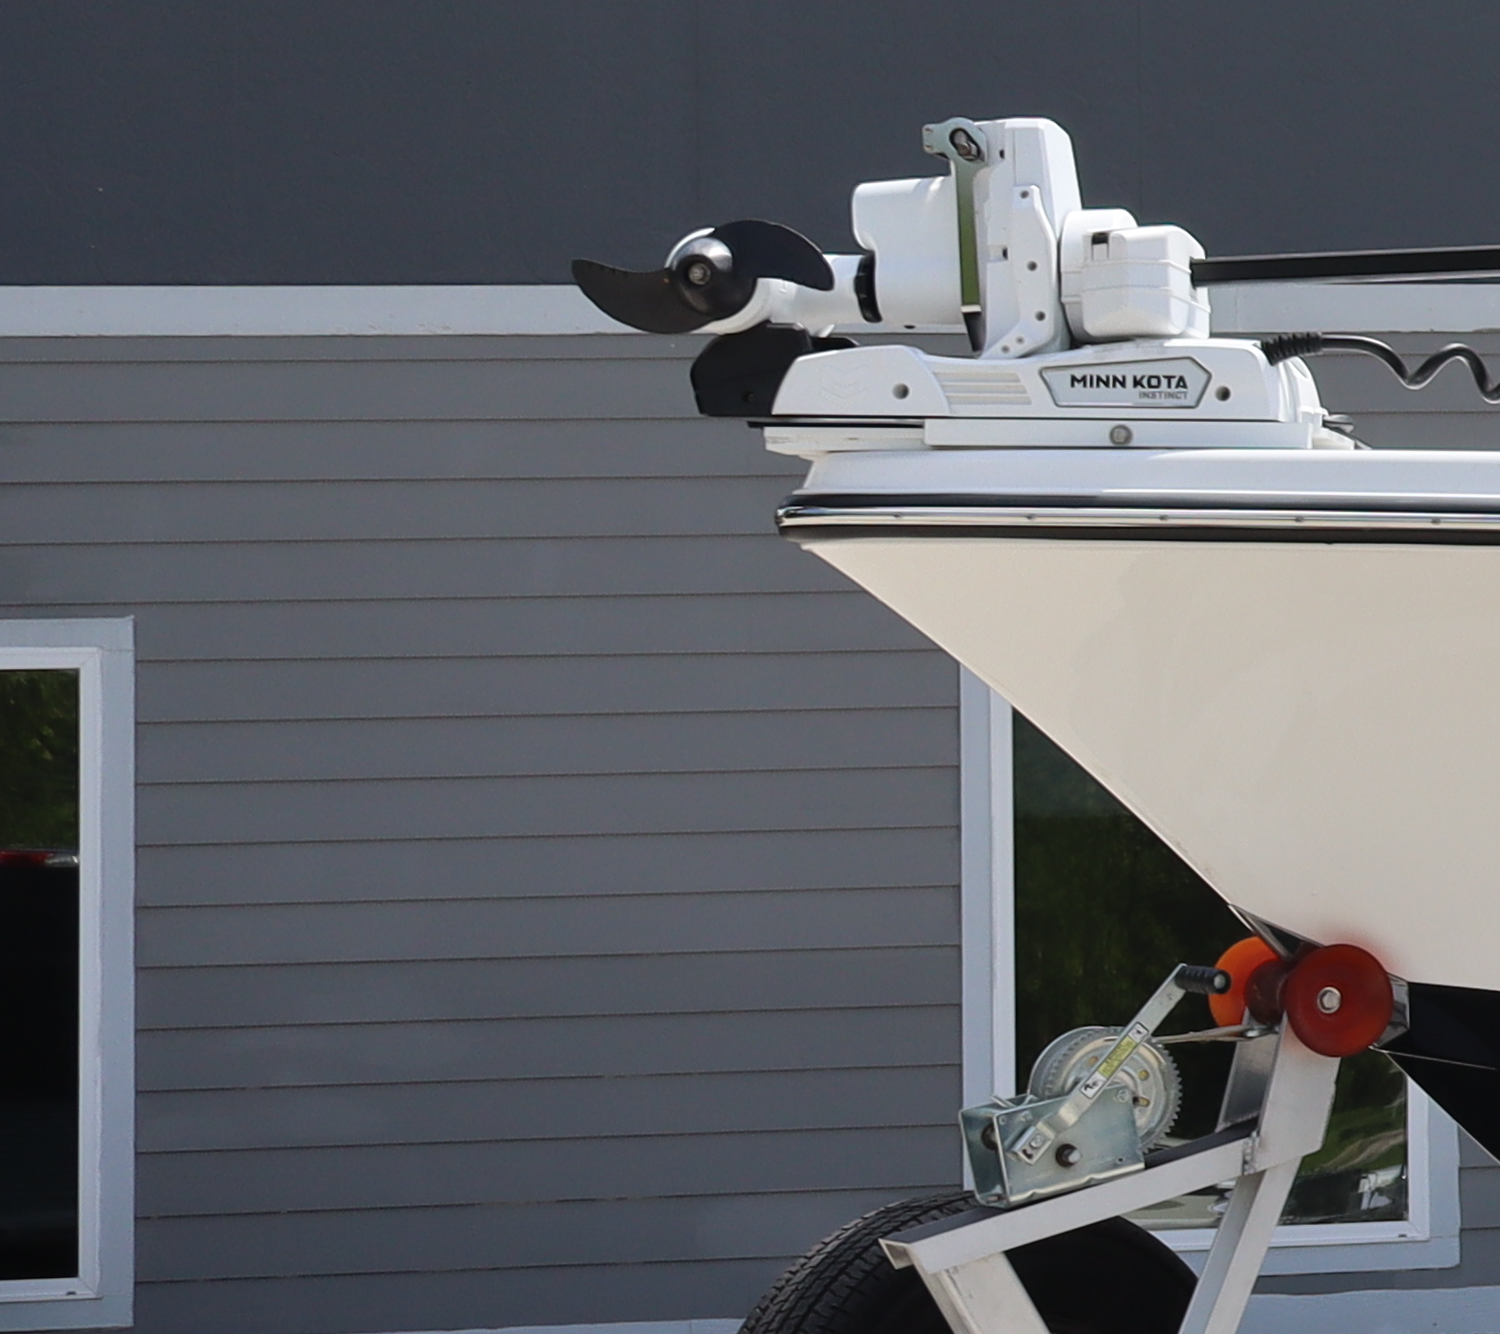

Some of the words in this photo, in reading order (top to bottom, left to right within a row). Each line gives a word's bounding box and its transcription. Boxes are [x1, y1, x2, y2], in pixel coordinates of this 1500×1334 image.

[1070, 374, 1126, 389] MINN
[1132, 375, 1188, 389] KOTA
[1138, 391, 1188, 400] INSTINCT
